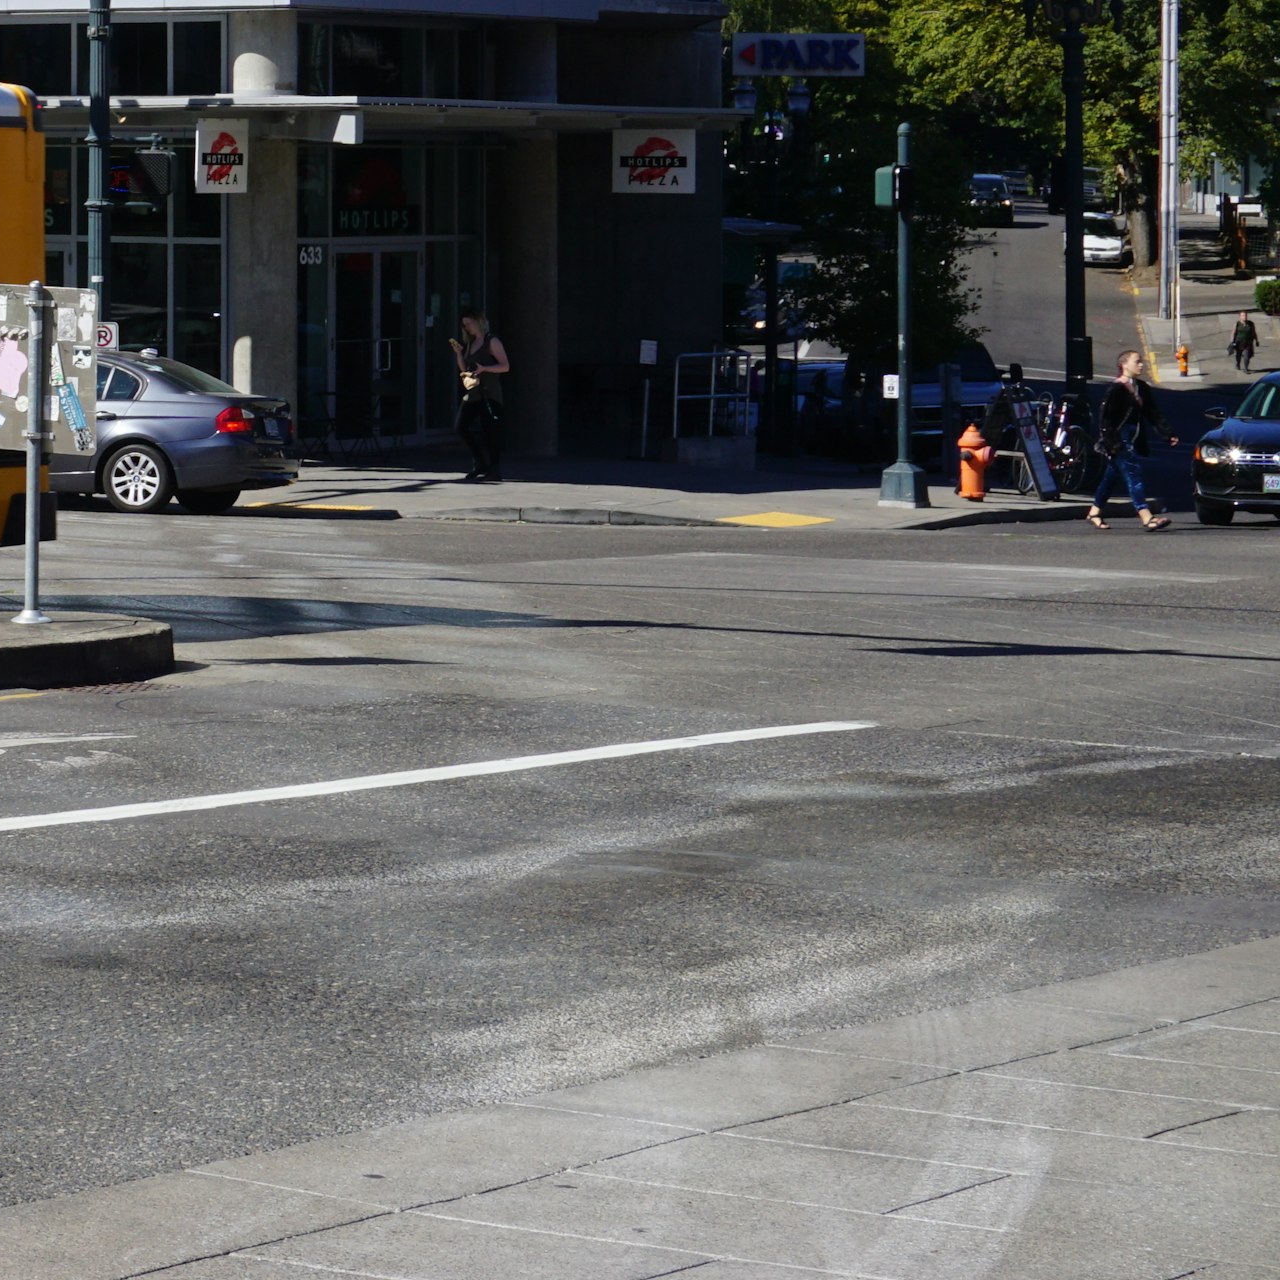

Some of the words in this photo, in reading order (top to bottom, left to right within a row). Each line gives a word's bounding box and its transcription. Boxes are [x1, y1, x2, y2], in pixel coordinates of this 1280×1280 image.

[760, 39, 860, 70] PARK
[206, 155, 239, 164] HOTLIPS
[628, 158, 680, 166] HOTLIPS
[206, 173, 238, 185] PIZZA
[628, 175, 679, 186] PIZZA
[339, 209, 409, 229] HOTLIPS
[300, 246, 323, 265] 633
